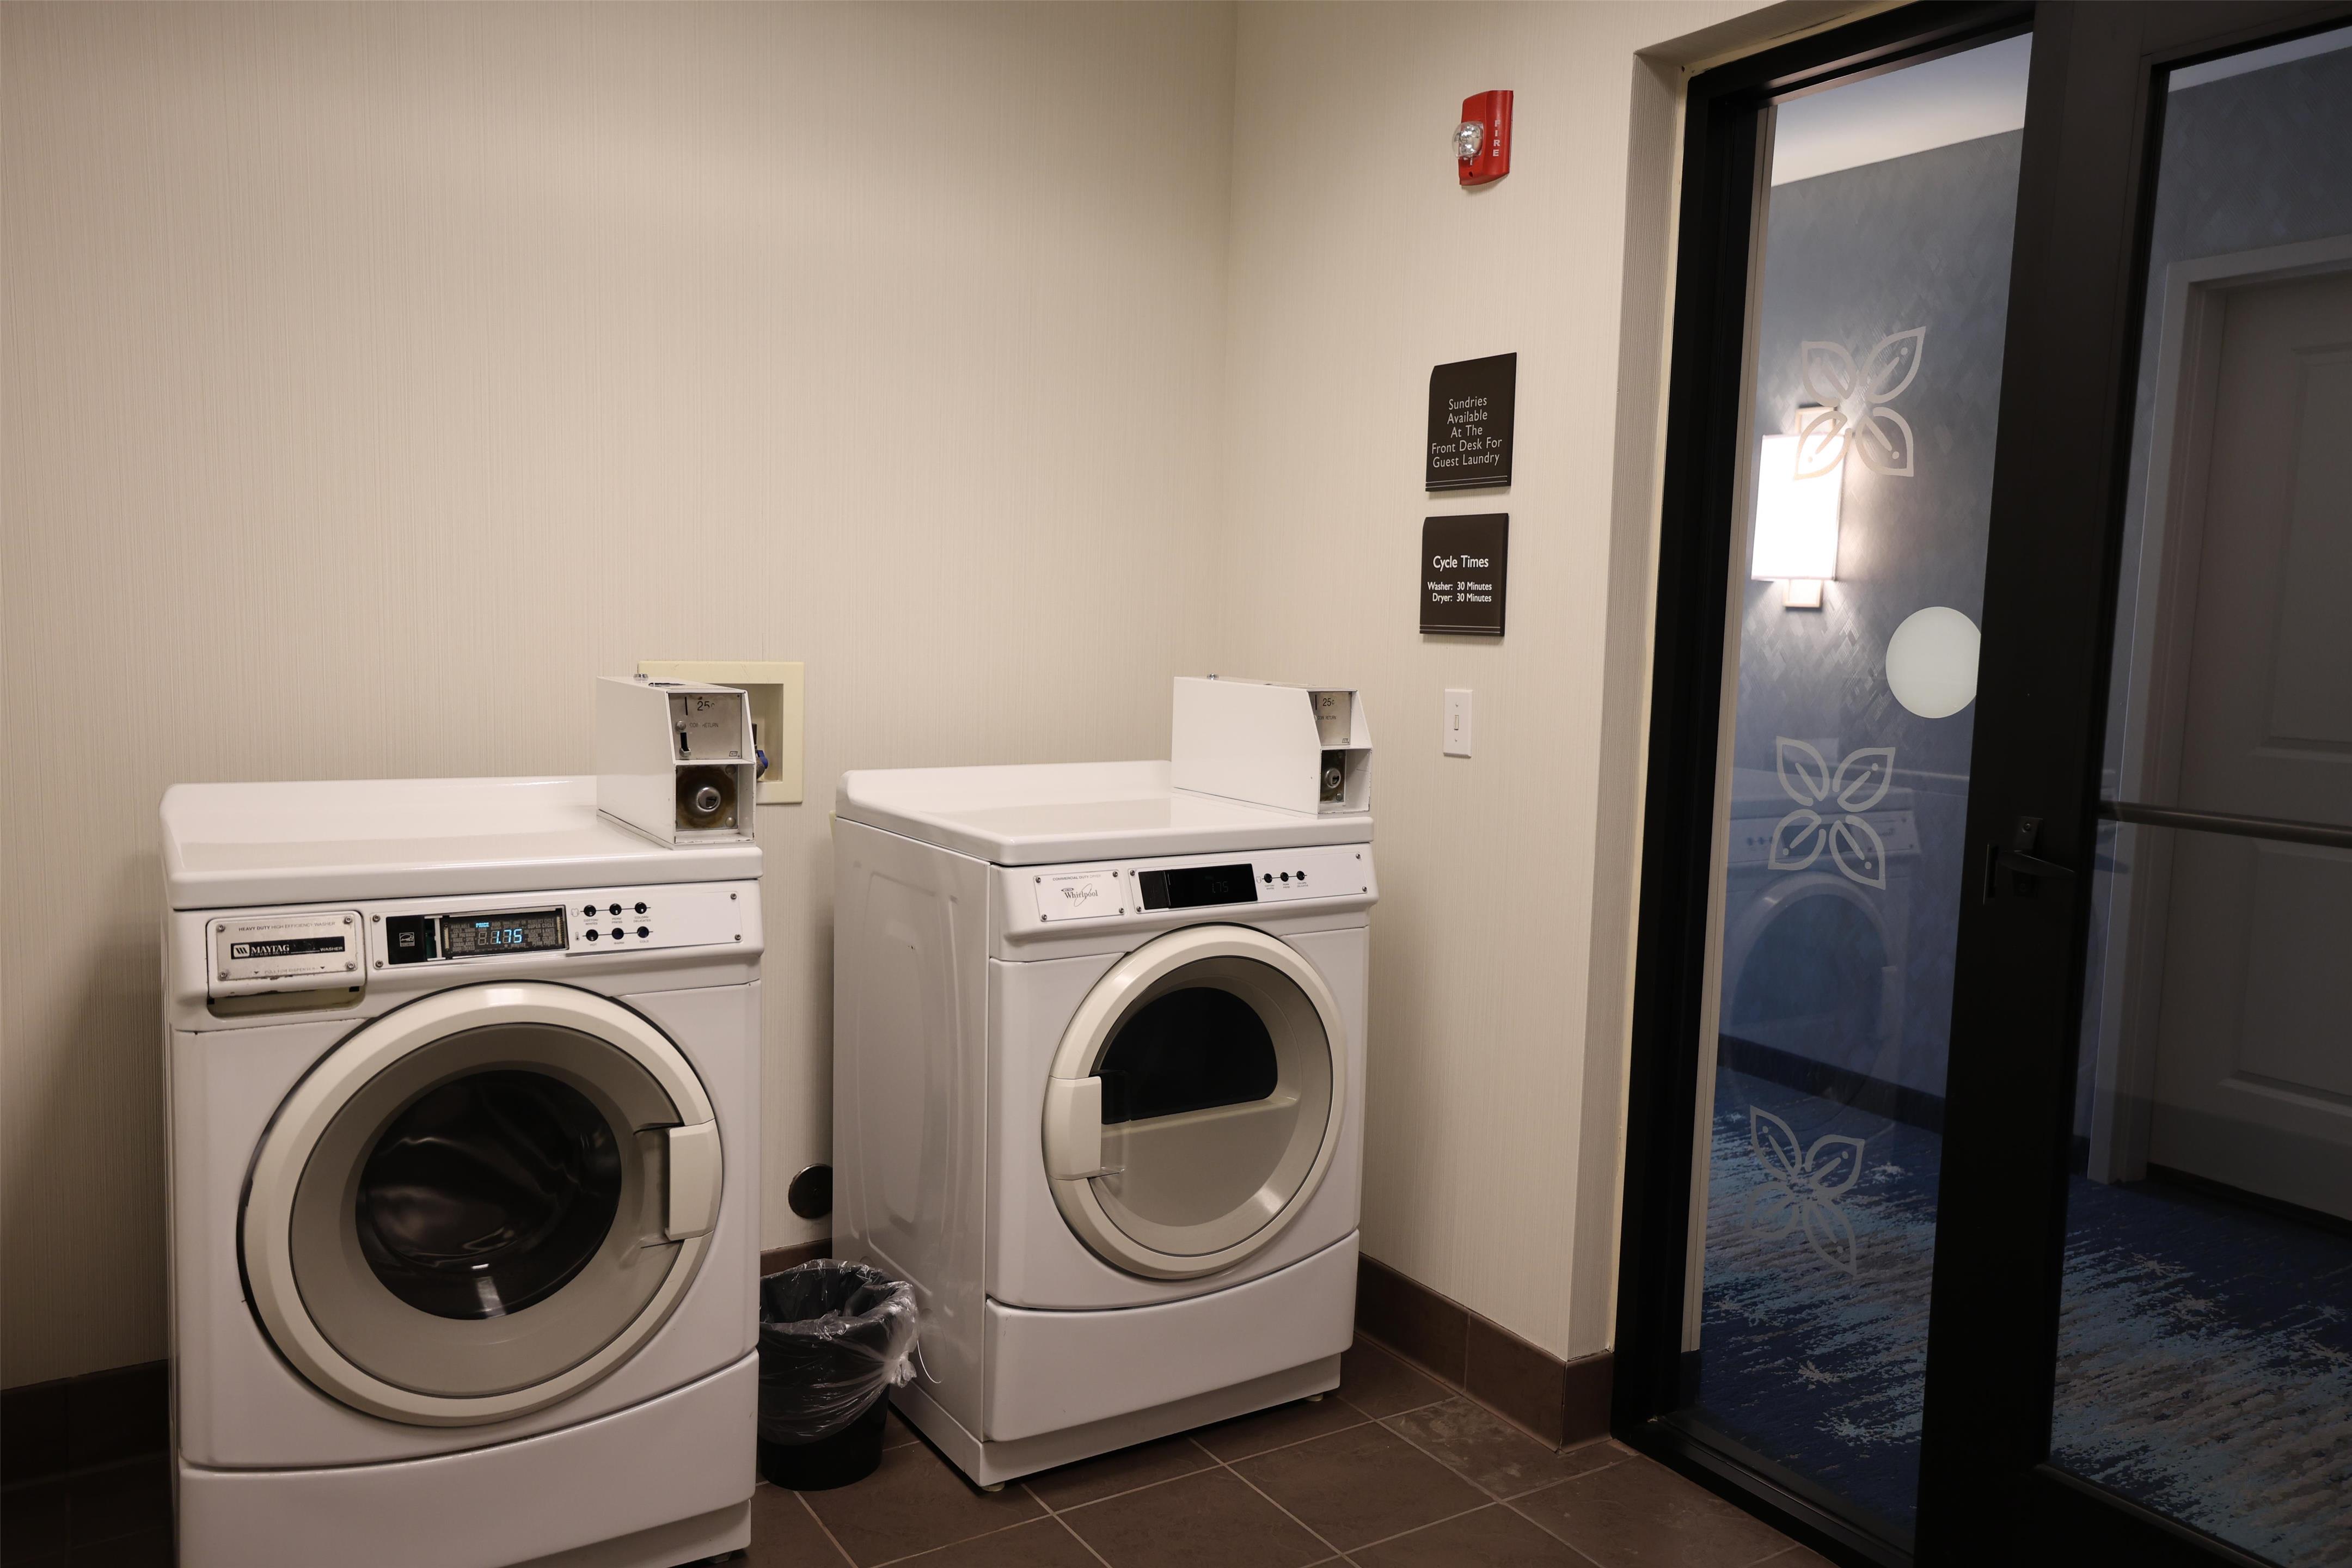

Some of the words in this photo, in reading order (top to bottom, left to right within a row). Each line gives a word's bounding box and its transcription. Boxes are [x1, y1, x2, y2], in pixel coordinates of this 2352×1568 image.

[1492, 120, 1500, 157] FIRE
[1449, 396, 1487, 410] Sundries
[1447, 409, 1487, 424] Available
[1450, 426, 1461, 438] At
[1465, 425, 1483, 437] The
[1432, 443, 1455, 454] Front
[1459, 438, 1482, 451] Desk
[1486, 437, 1502, 449] For
[1432, 457, 1459, 468] Guest
[1462, 451, 1500, 466] Laundry
[1432, 555, 1457, 572] Cycle
[1460, 555, 1489, 568] Times
[1427, 581, 1453, 591] Washer:
[1456, 581, 1465, 591] 30
[1467, 581, 1492, 591] Minutes
[1432, 593, 1453, 604] Dryer:
[1456, 593, 1465, 602] 30
[1466, 593, 1492, 602] Minutes
[1064, 890, 1098, 899] Whirlpool
[495, 928, 523, 944] 1.75
[251, 945, 290, 954] MAYTAG
